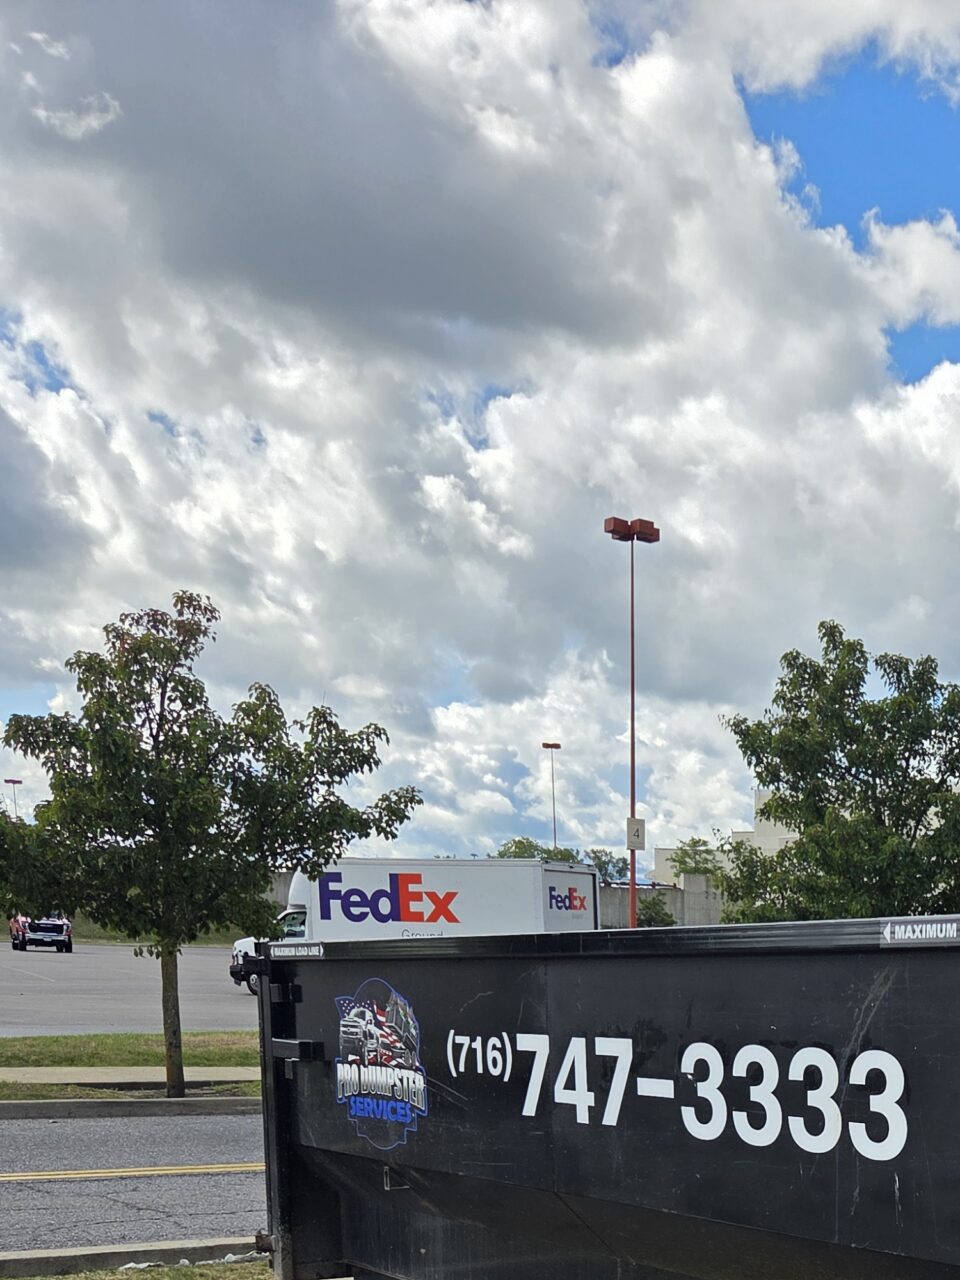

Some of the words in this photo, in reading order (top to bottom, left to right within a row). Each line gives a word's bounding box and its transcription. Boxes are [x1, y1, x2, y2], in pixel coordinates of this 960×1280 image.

[633, 828, 640, 840] 4
[318, 871, 461, 923] FedEx
[548, 886, 588, 911] FedEx
[894, 922, 957, 940] MAXIMUM
[337, 1062, 360, 1099] PRO
[360, 1065, 425, 1110] DUMPSTER
[350, 1096, 412, 1123] SERVICES
